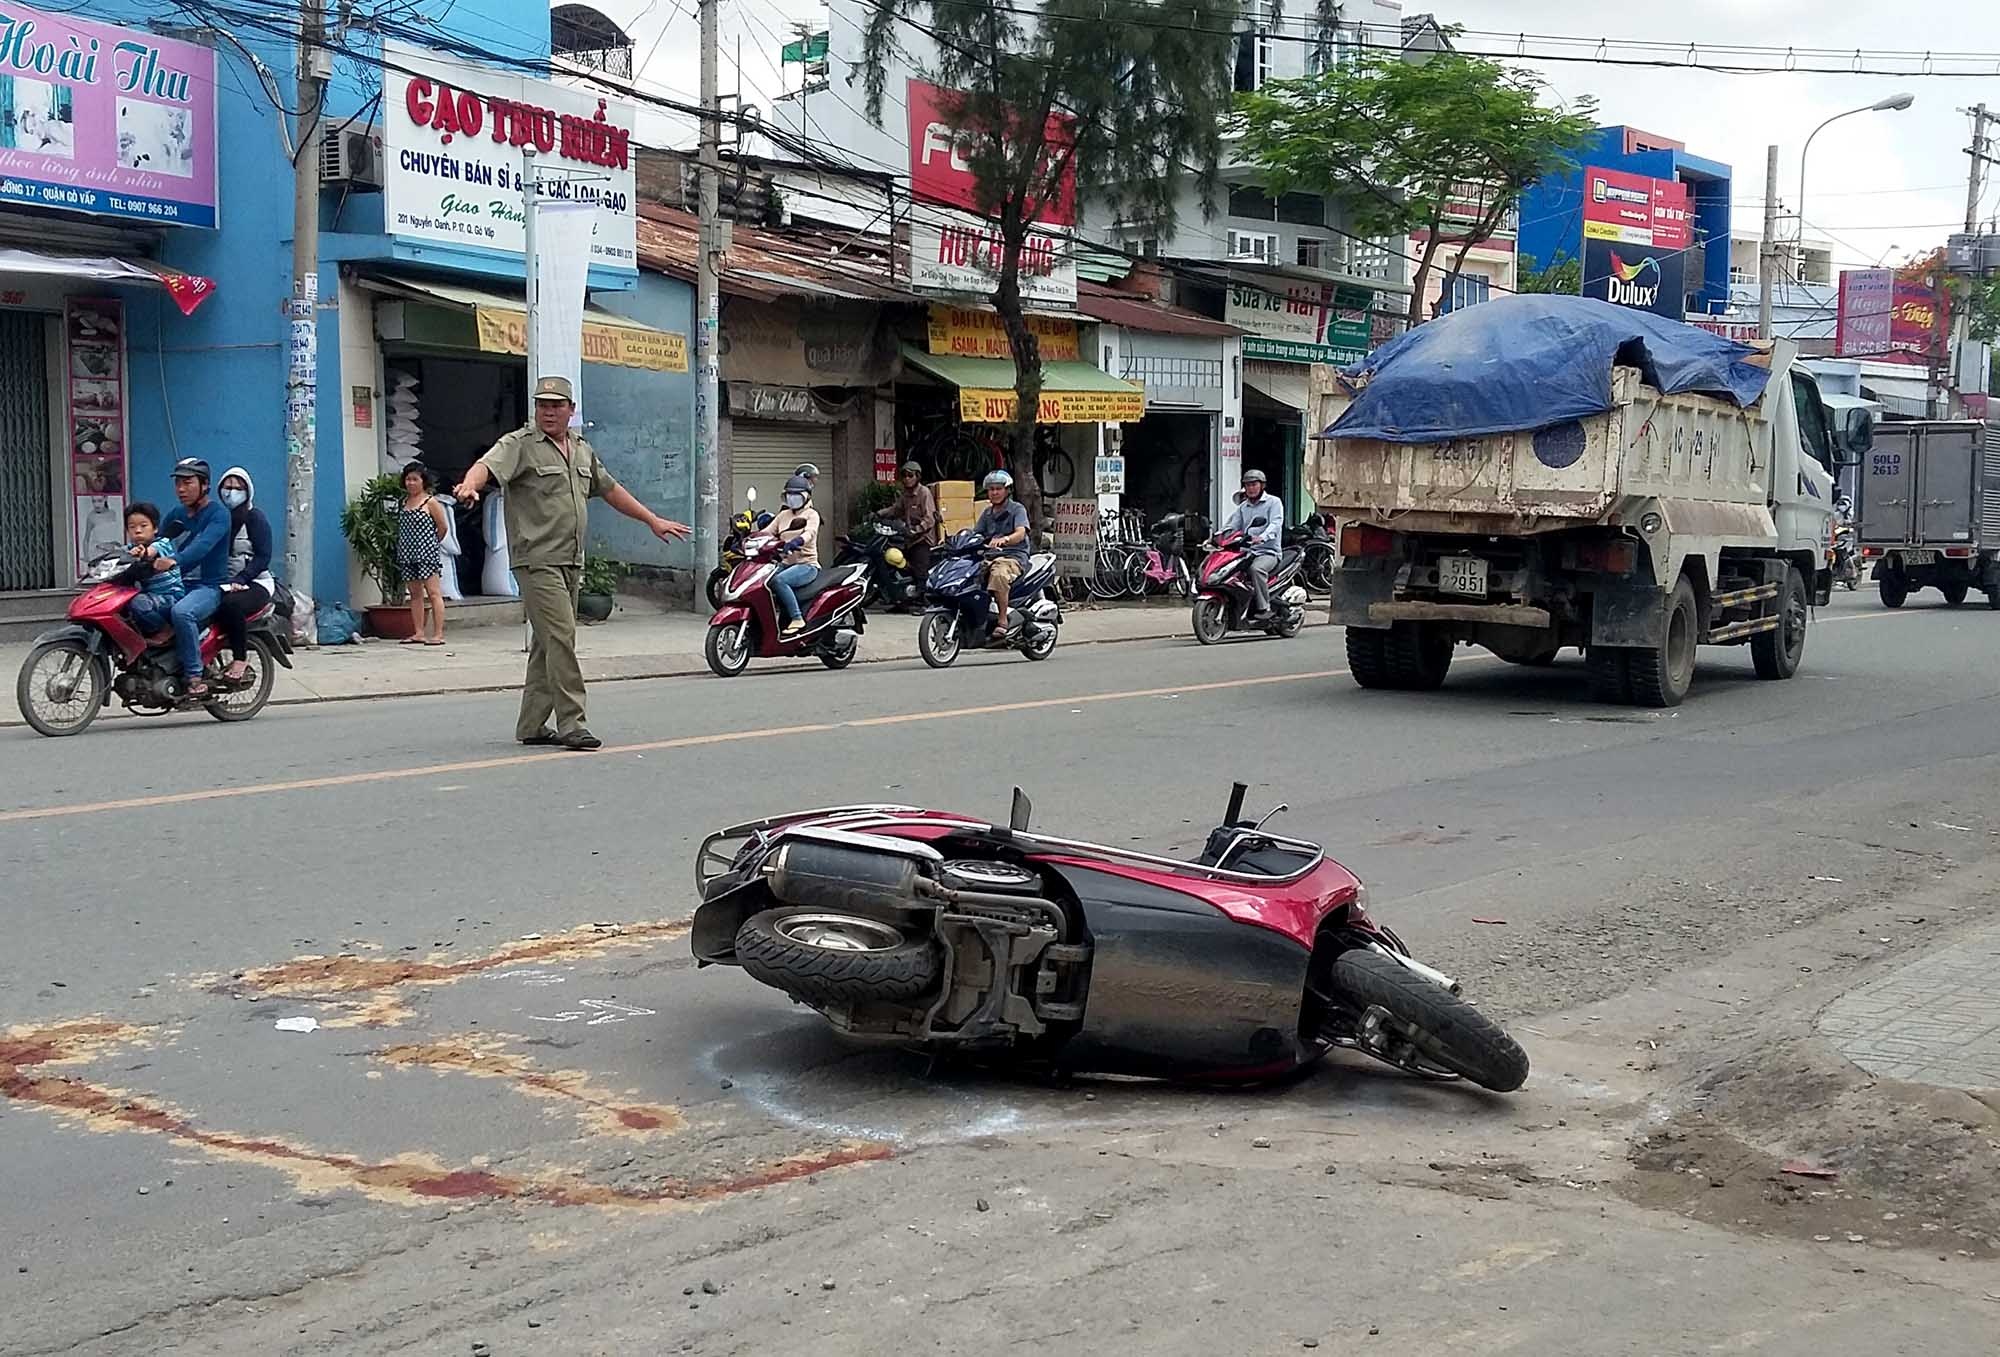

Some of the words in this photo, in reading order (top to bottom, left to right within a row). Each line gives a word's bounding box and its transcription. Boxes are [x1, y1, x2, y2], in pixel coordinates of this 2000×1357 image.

[0, 13, 99, 83] Hoài
[112, 41, 191, 101] Thu
[406, 76, 484, 145] GẠO
[486, 96, 555, 154] THU
[559, 97, 631, 170] HIỀN
[399, 149, 460, 180] CHUYÊN
[464, 159, 492, 187] BÁN
[497, 162, 510, 189] SỈ
[514, 172, 524, 192] &
[548, 175, 571, 200] CÁC
[604, 190, 627, 215] GẠO
[26, 185, 36, 197] 17
[43, 187, 65, 202] QUẬN
[67, 190, 78, 204] GÒ
[80, 189, 96, 205] VẤP
[440, 193, 480, 218] Giao
[110, 197, 126, 211] TEL:
[128, 201, 146, 214] 0907
[164, 206, 178, 217] 204
[937, 223, 984, 268] HUY
[1608, 277, 1653, 306] Dulux
[951, 335, 978, 353] ASAMA
[985, 398, 1011, 419] HUY
[1872, 454, 1901, 465] 60LD
[1872, 465, 1900, 476] 2613
[1451, 559, 1478, 577] 51C
